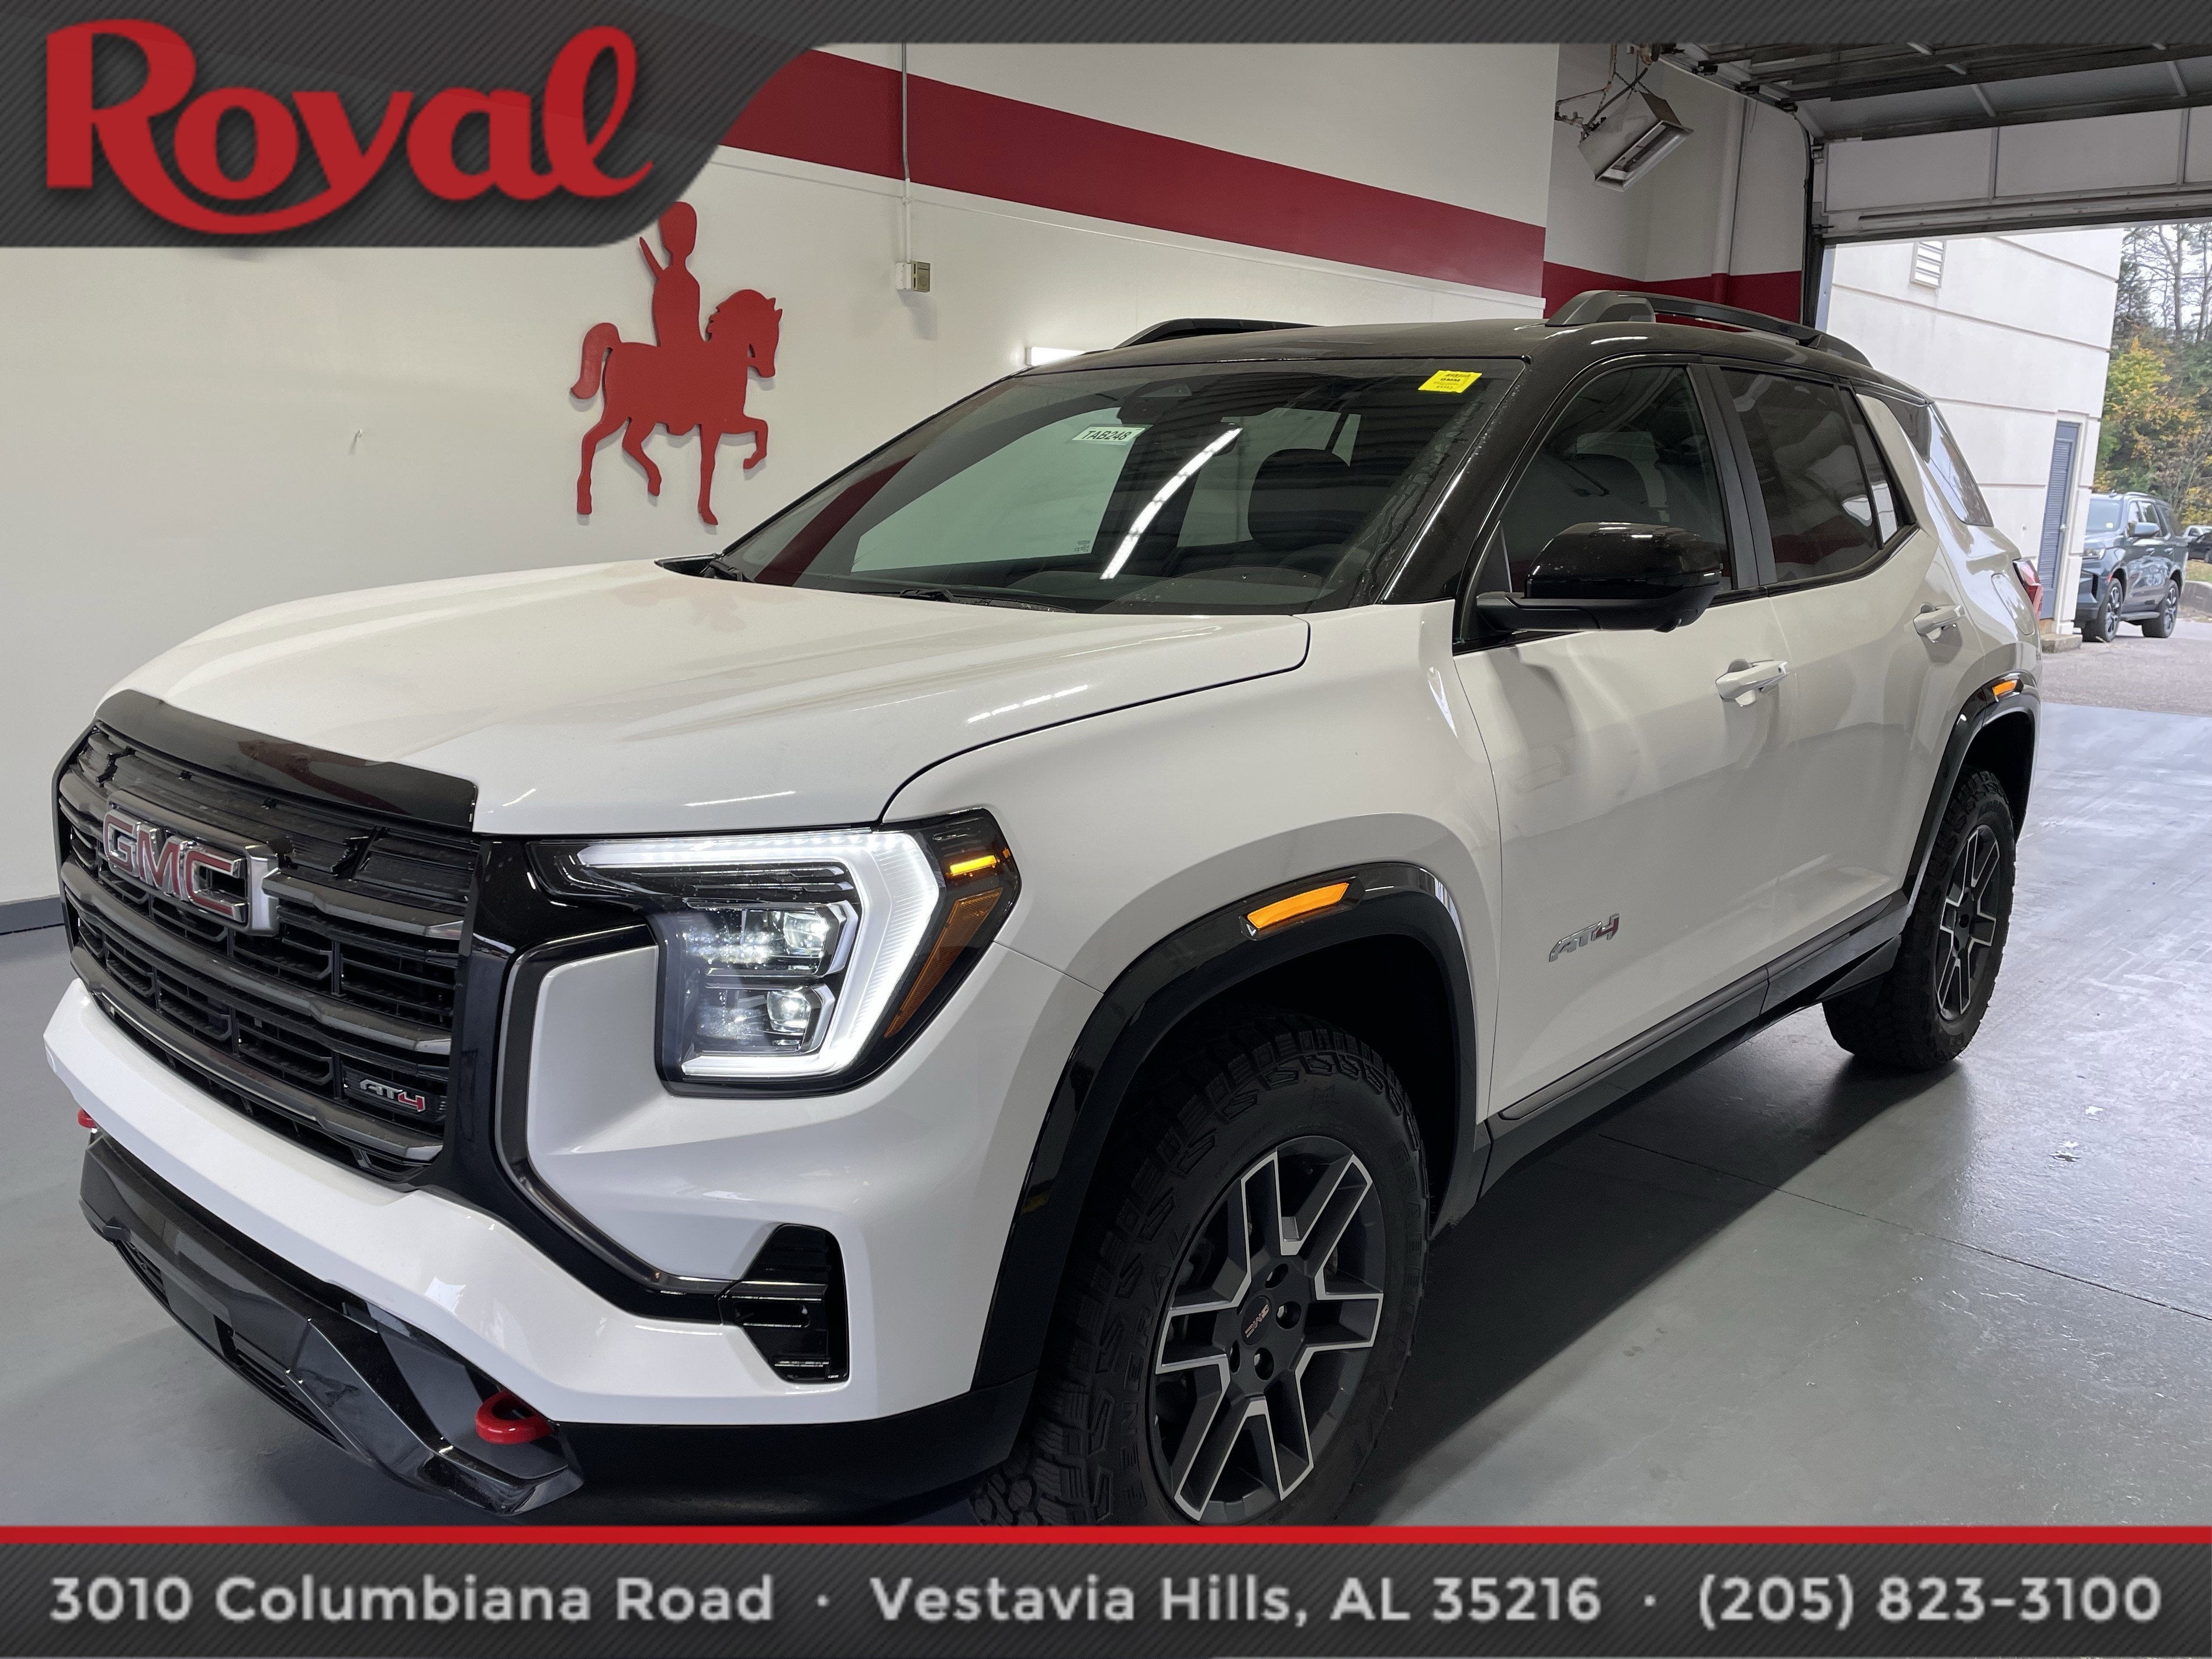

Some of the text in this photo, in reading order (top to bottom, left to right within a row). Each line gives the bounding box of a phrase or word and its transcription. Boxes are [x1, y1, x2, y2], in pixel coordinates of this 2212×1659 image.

[1081, 431, 1132, 441] TAB248
[103, 809, 247, 923] GMC
[1549, 913, 1620, 962] AT4
[360, 1079, 426, 1112] AT4
[1245, 1304, 1270, 1338] GMC
